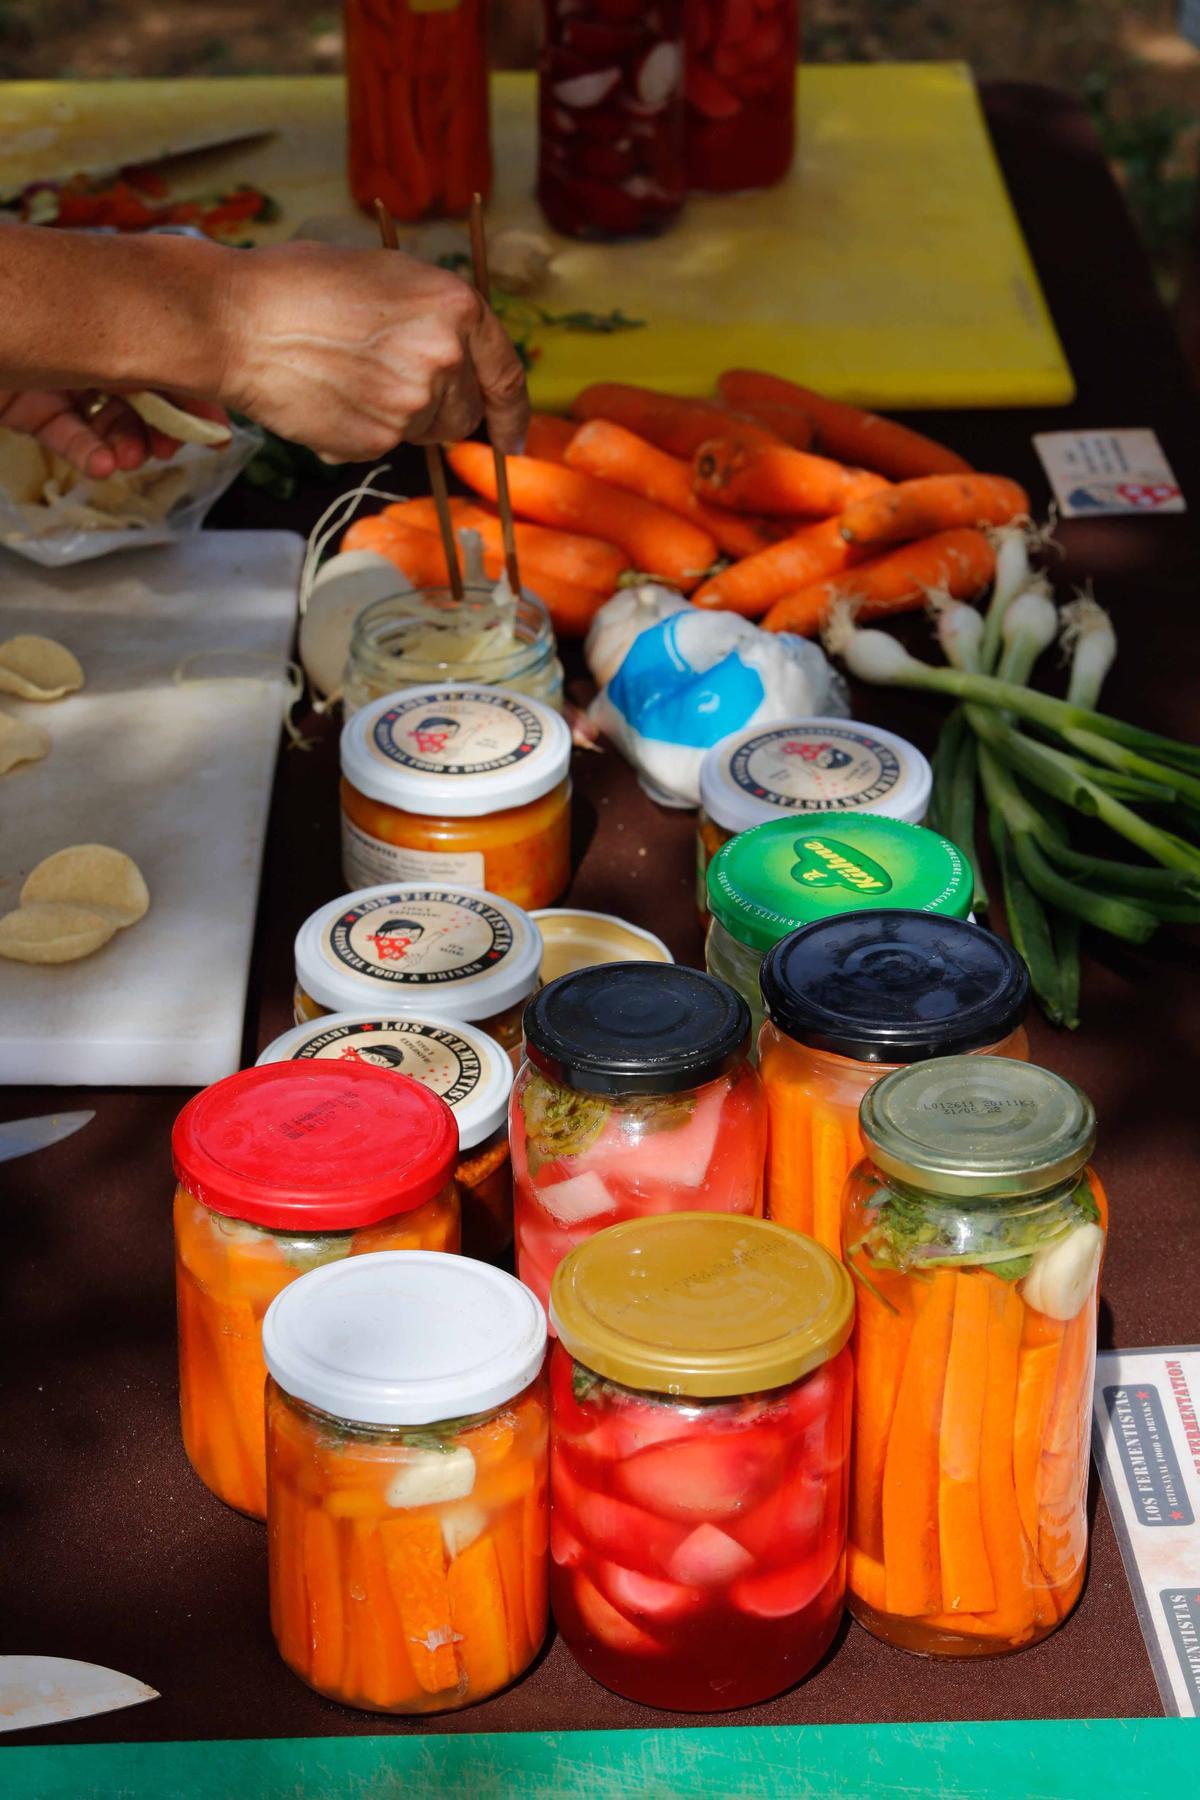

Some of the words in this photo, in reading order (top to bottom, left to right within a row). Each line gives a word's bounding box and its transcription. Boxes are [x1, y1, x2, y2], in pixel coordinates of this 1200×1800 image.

[804, 841, 883, 889] Kühne
[354, 896, 392, 917] LOS
[399, 891, 513, 952] FERMENTISTAS
[334, 927, 365, 969] ARTISANAL
[366, 966, 405, 981] FOOD
[409, 973, 420, 982] &
[426, 963, 484, 981] DRINKS
[298, 1026, 350, 1058] ARTISAN
[381, 1022, 424, 1033] LOS
[429, 1029, 480, 1106] FERMENTIST
[1143, 1402, 1158, 1432] DRINKS
[1113, 1390, 1154, 1492] FERMENTISTAS
[1152, 1441, 1166, 1463] FOOD
[1159, 1464, 1179, 1506] ARTISANAL
[1141, 1497, 1162, 1522] LOS
